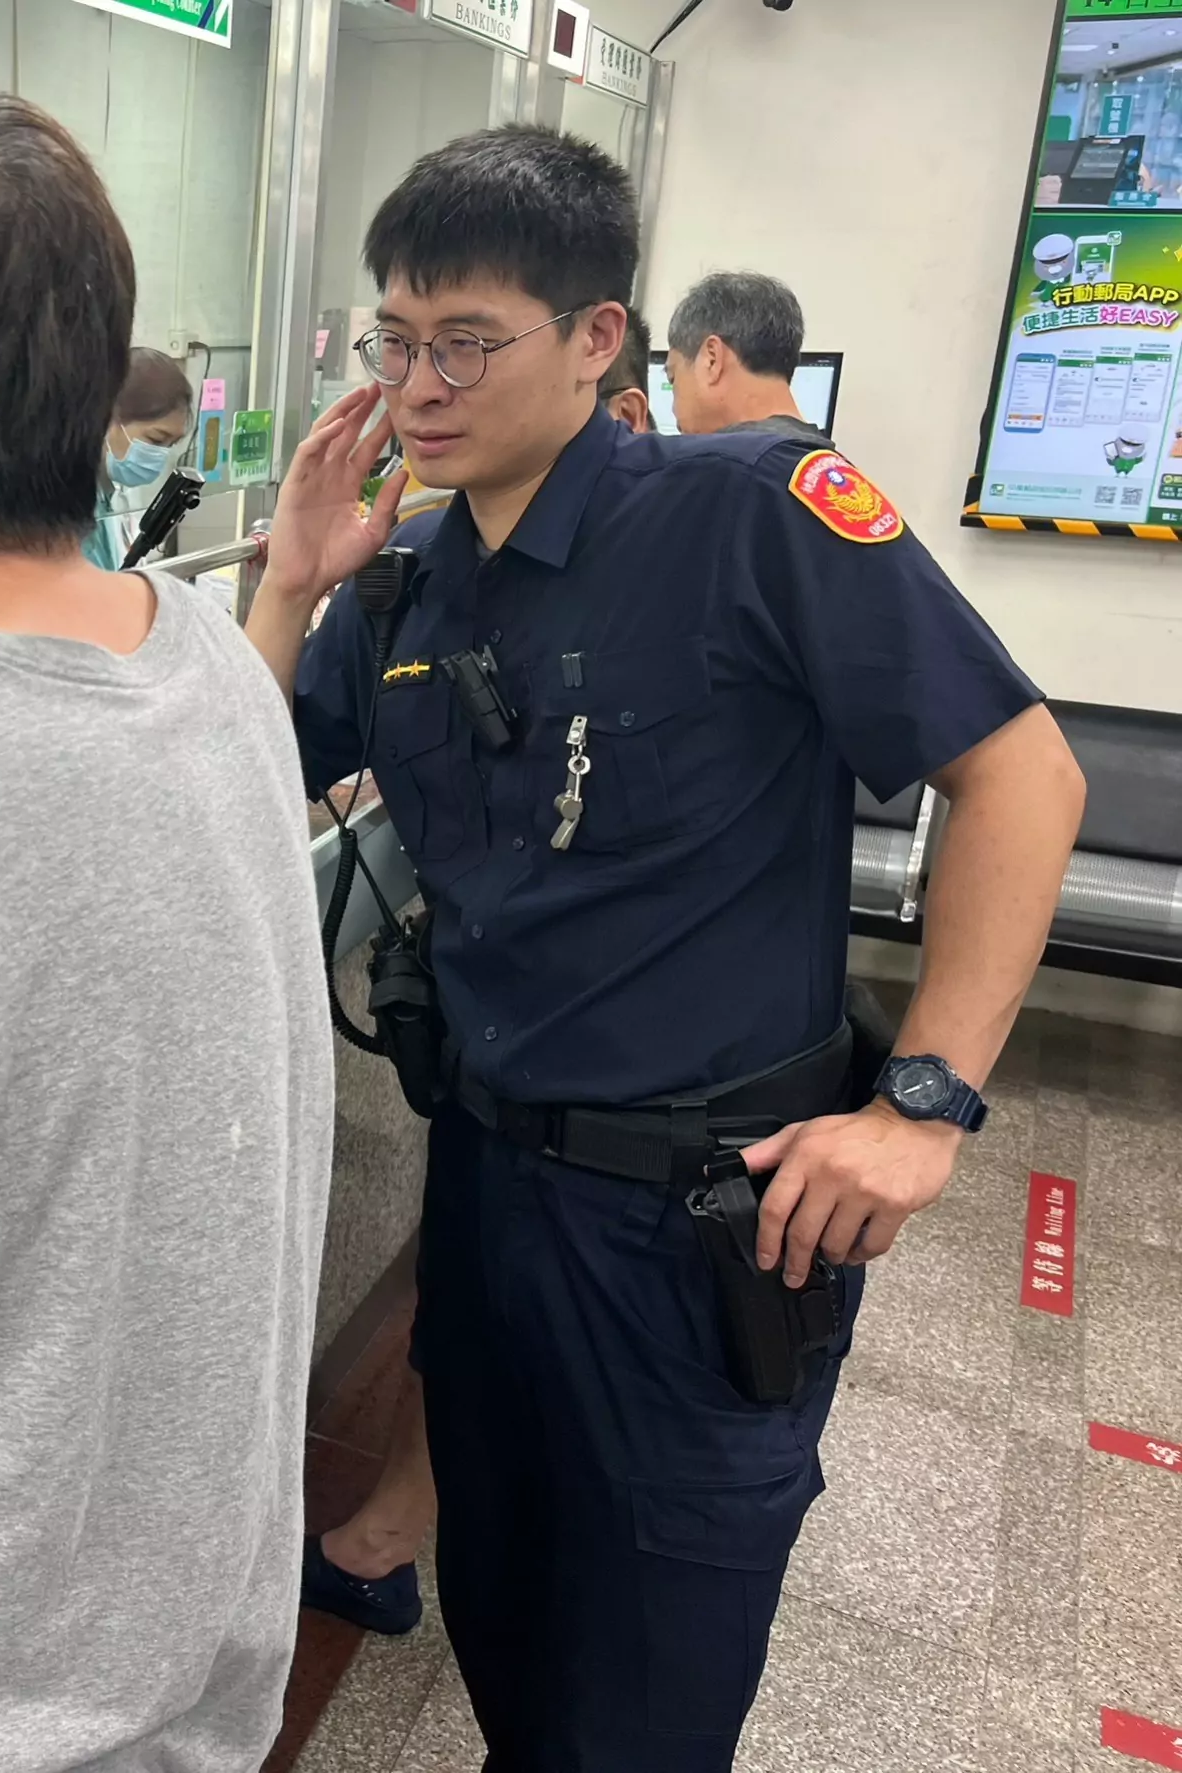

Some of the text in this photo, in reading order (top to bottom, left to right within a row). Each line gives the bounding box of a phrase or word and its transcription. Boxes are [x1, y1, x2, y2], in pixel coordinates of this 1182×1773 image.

[455, 3, 511, 41] BANKINGS
[601, 71, 638, 98] BANKINGS
[1052, 282, 1180, 306] 行動郵局APP
[1022, 304, 1180, 334] 便捷生活好EASY
[1031, 1187, 1066, 1293] 等待線 Waiting Line
